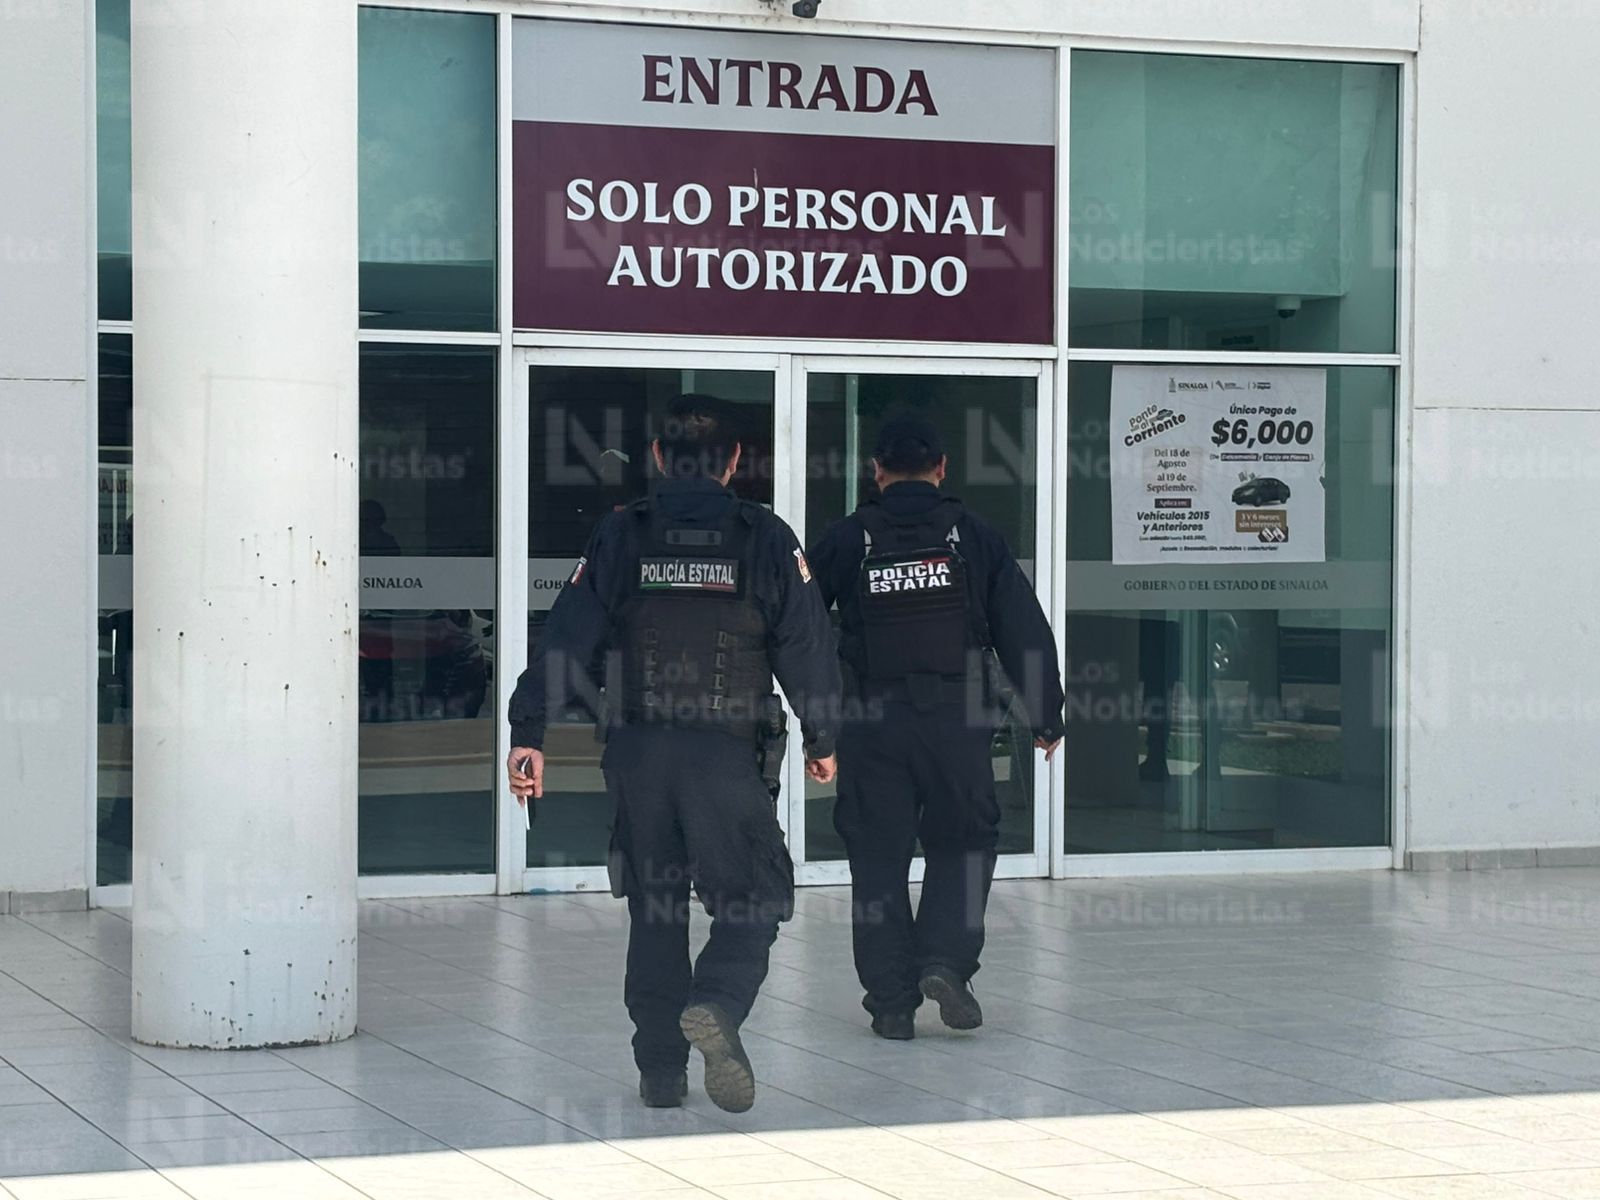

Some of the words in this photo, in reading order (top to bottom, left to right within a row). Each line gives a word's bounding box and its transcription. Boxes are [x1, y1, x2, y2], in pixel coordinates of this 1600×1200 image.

[642, 54, 939, 116] ENTRADA
[566, 179, 712, 226] SOLO
[728, 184, 1007, 237] PERSONAL
[606, 245, 968, 297] AUTORIZADO
[1229, 402, 1257, 415] Único
[1258, 406, 1283, 418] Pago
[1284, 406, 1297, 415] de
[1124, 413, 1186, 447] Corriente
[1211, 417, 1314, 449] $6,000
[1154, 449, 1168, 457] Del
[1180, 448, 1190, 457] de
[1157, 460, 1187, 470] Agosto
[1156, 473, 1165, 481] al
[1176, 473, 1187, 481] de
[1146, 484, 1197, 494] Septiembre.
[1137, 511, 1186, 521] Vehículos
[1187, 511, 1210, 520] 2015
[1143, 524, 1150, 534] y
[1151, 522, 1203, 532] Anteriores
[641, 559, 686, 582] POLICÍA
[688, 563, 735, 584] ESTATAL
[363, 577, 423, 589] SINALOA
[869, 574, 951, 594] ESTATAL
[1123, 579, 1187, 591] GOBIERNO
[1188, 579, 1209, 591] DEL
[1213, 579, 1259, 591] ESTADO
[1261, 579, 1277, 591] DE
[1278, 579, 1329, 591] SINALOA
